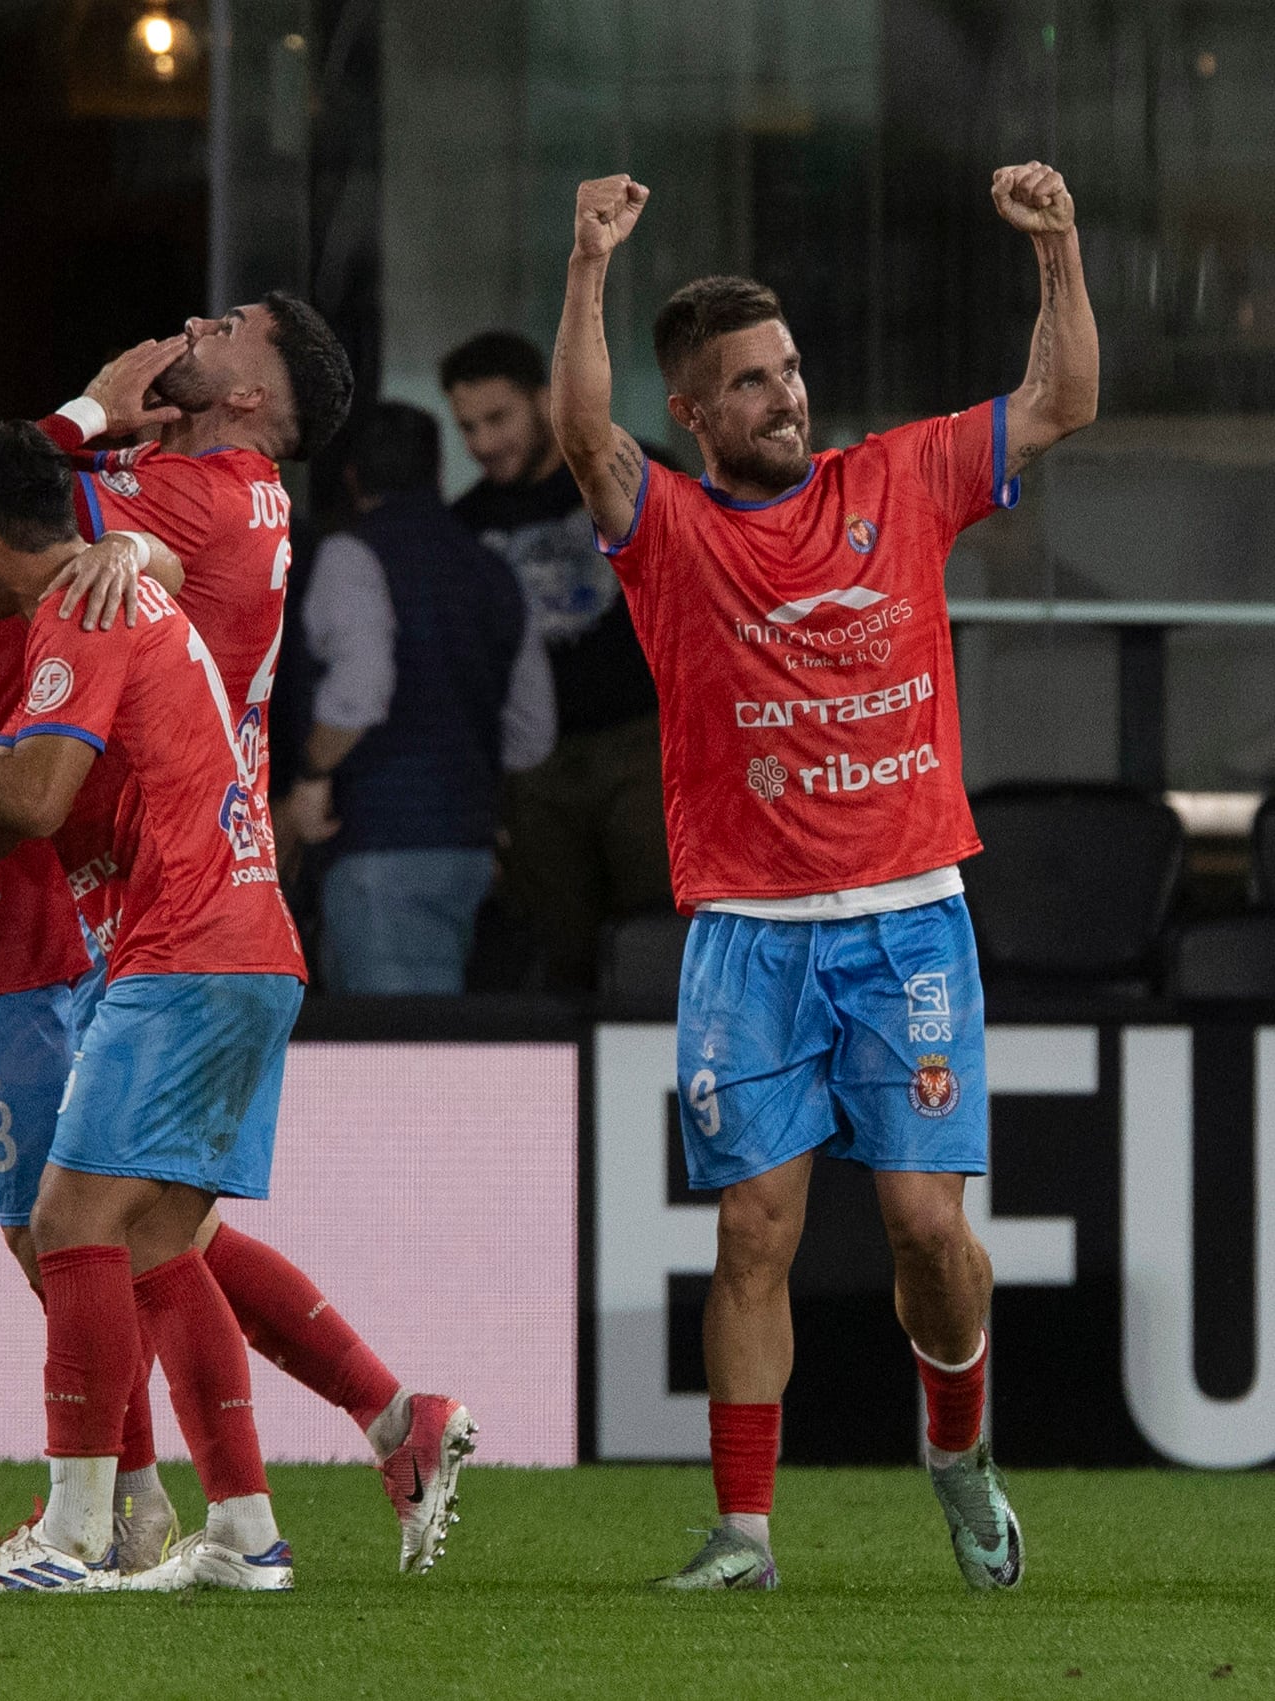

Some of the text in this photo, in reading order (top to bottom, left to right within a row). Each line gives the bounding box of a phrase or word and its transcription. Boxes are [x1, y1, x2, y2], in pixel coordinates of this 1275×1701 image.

[799, 743, 940, 795] ribera
[909, 1022, 952, 1043] ROS
[689, 1069, 721, 1137] 9
